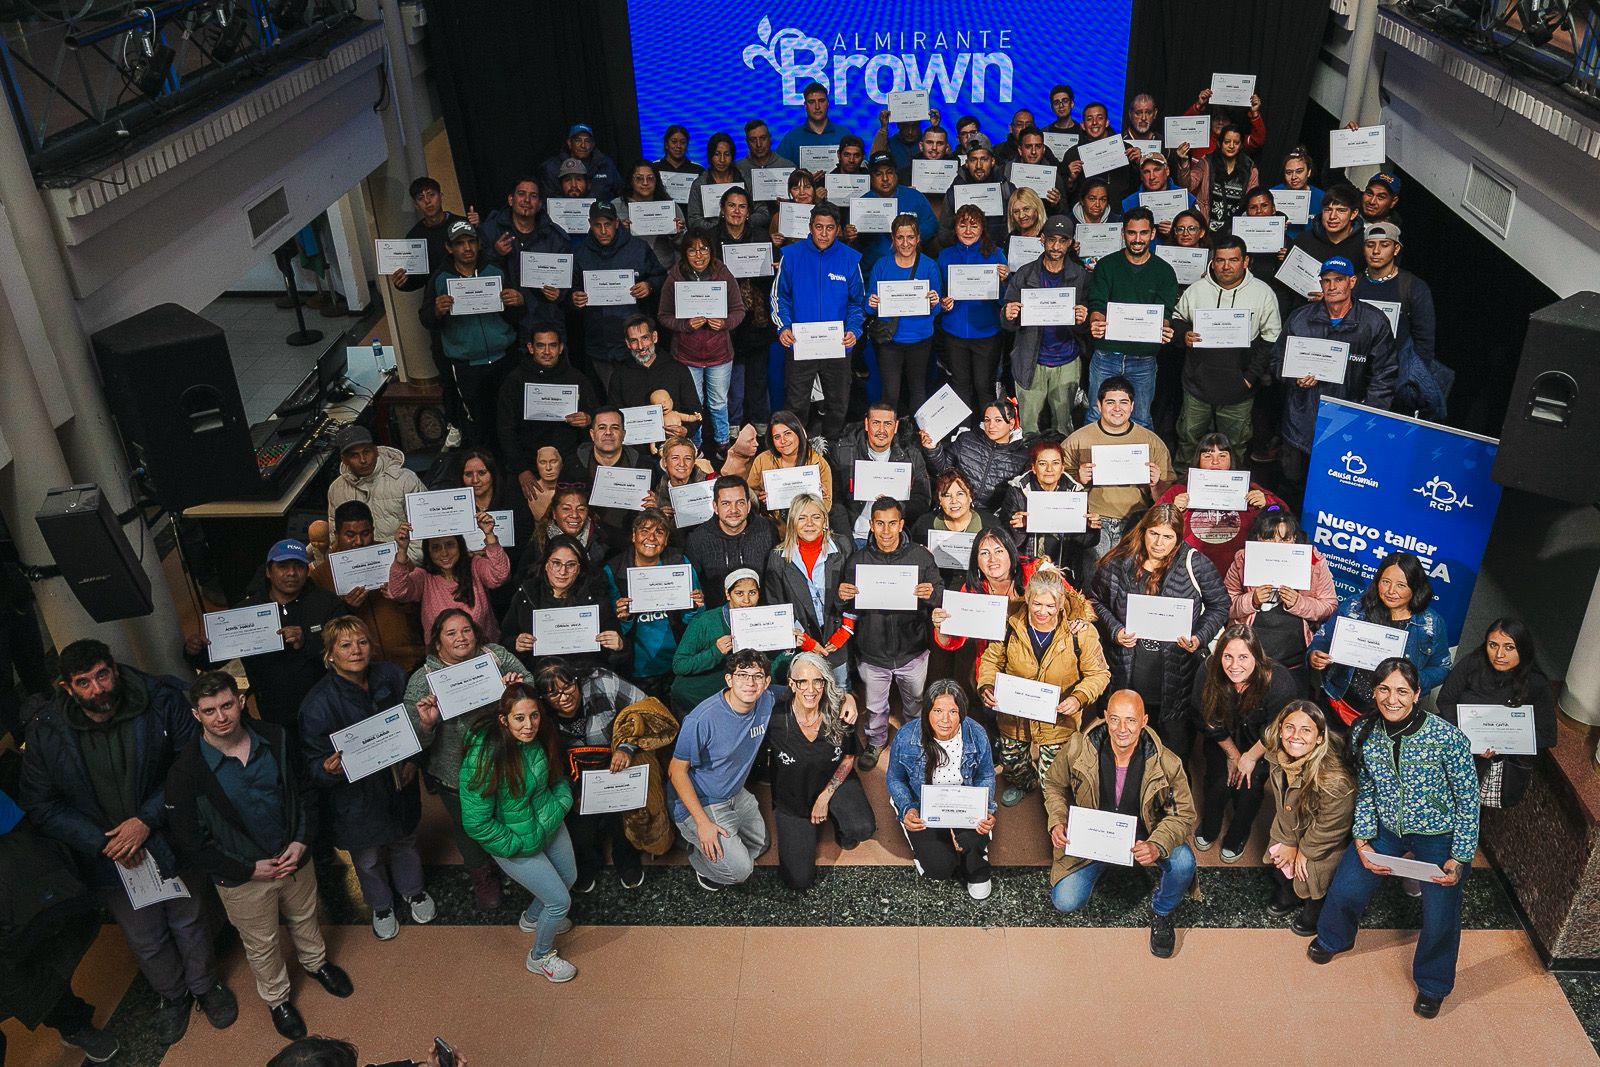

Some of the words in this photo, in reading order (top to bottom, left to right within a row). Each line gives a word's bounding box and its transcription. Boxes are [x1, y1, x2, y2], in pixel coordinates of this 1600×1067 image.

[832, 29, 1012, 51] ALMIRANTE
[777, 32, 1014, 106] Brown
[1349, 353, 1368, 363] rown
[1429, 500, 1453, 512] RCP
[1313, 526, 1368, 554] RCP
[1372, 546, 1389, 560] +
[1317, 510, 1381, 540] Nuevo
[1384, 530, 1438, 556] taller
[1319, 552, 1361, 569] animación
